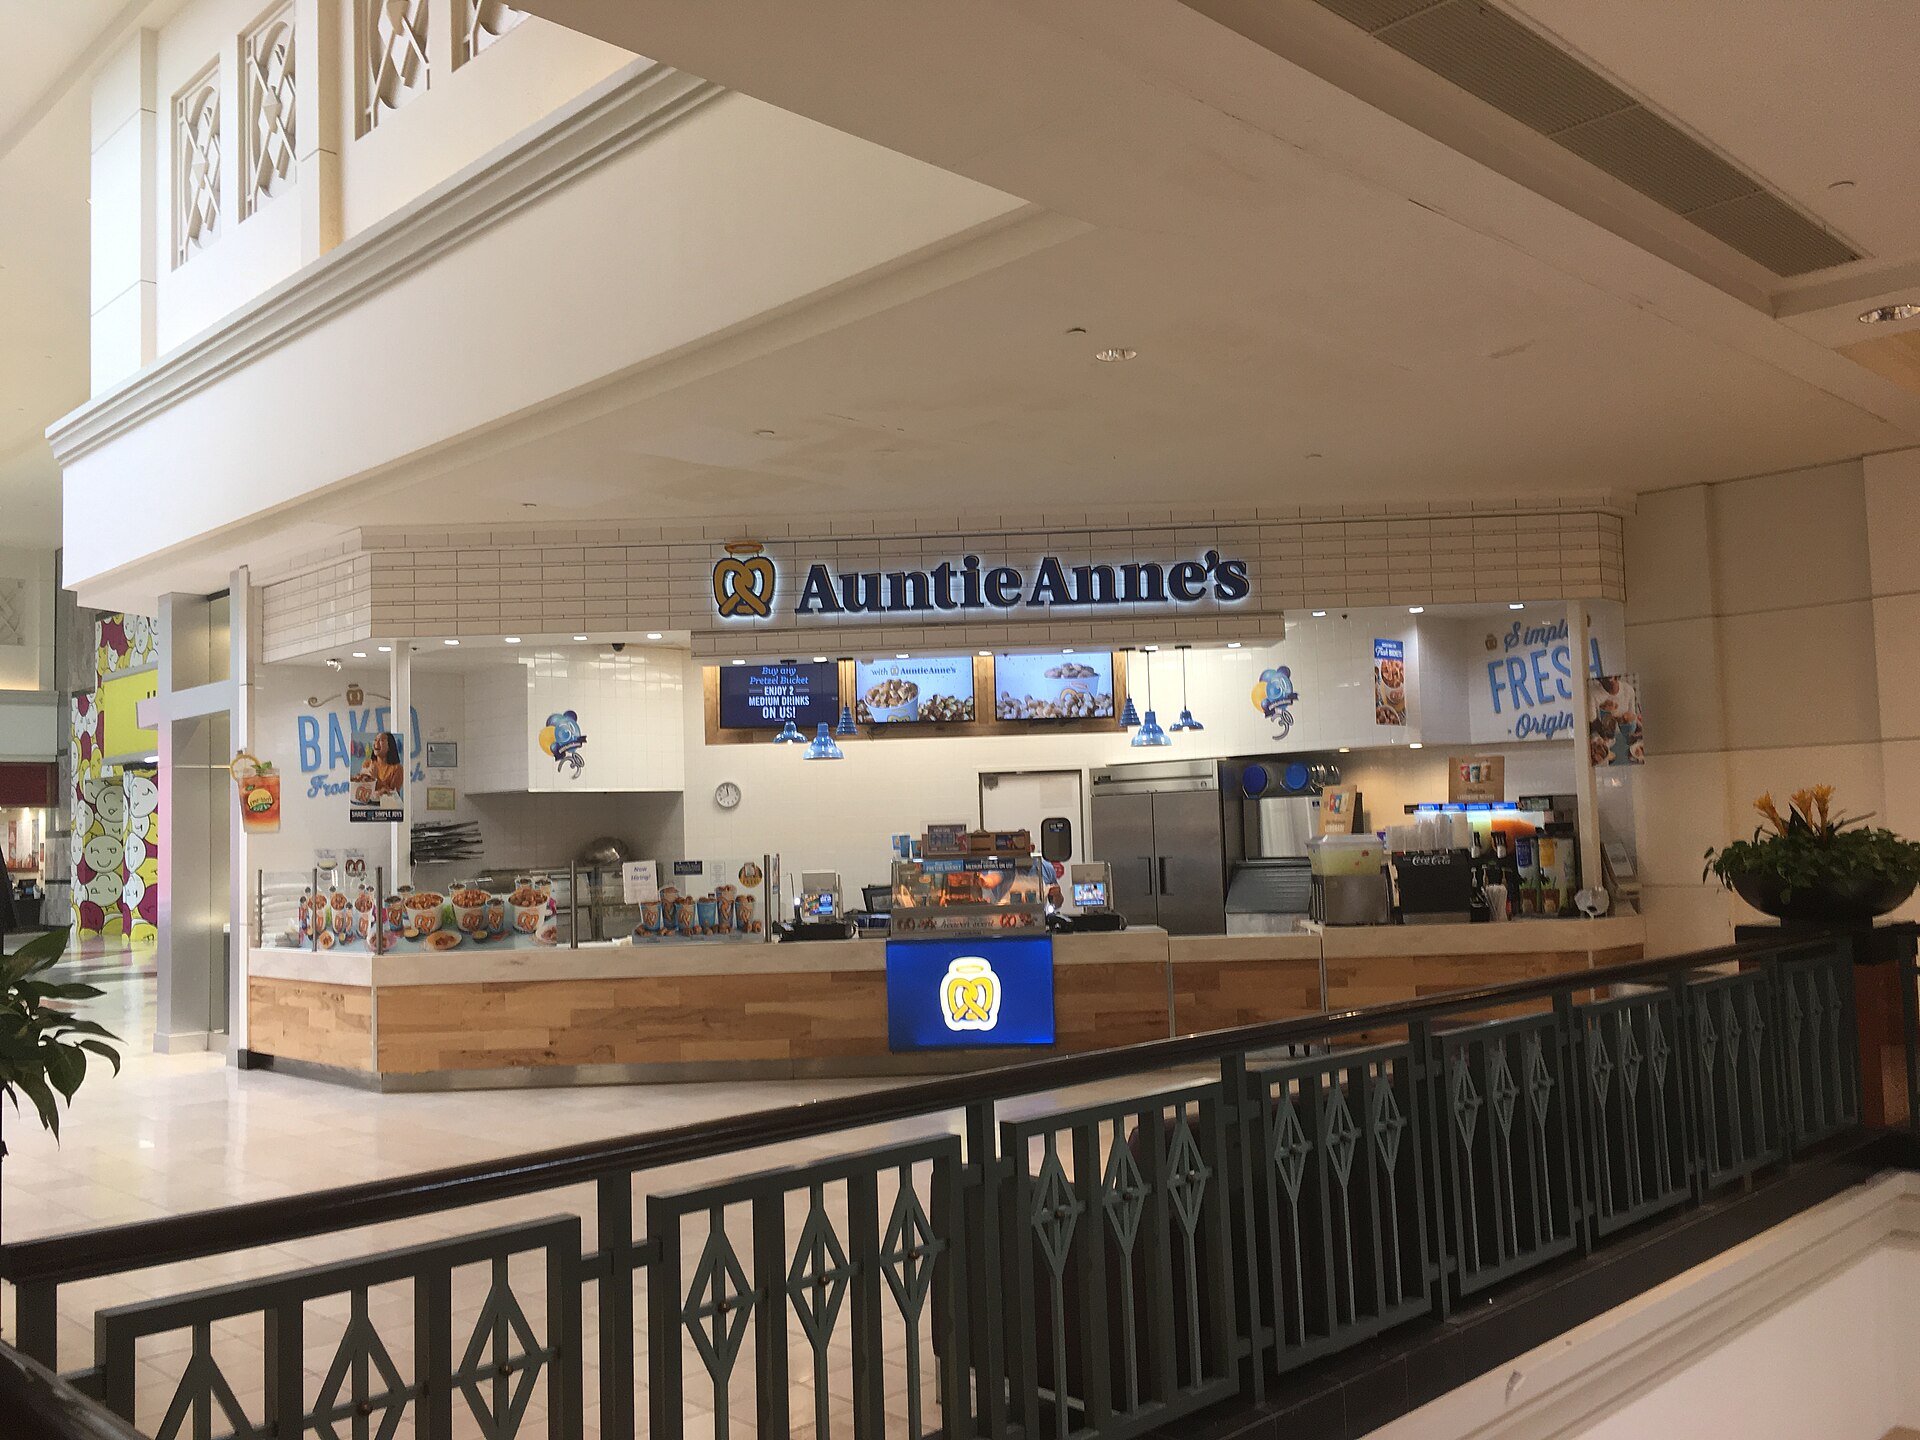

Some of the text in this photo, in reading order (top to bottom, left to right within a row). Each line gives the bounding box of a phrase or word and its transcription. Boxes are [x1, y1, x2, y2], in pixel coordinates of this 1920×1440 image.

[1504, 618, 1568, 652] Simpl
[761, 666, 797, 676] Buy any
[871, 667, 888, 676] with
[749, 675, 809, 685] Pretzel Bucket
[764, 686, 794, 695] ENJOY 2
[749, 695, 810, 706] MEDIUM DRINKS
[762, 706, 796, 719] ON US!
[1516, 711, 1573, 740] Origin
